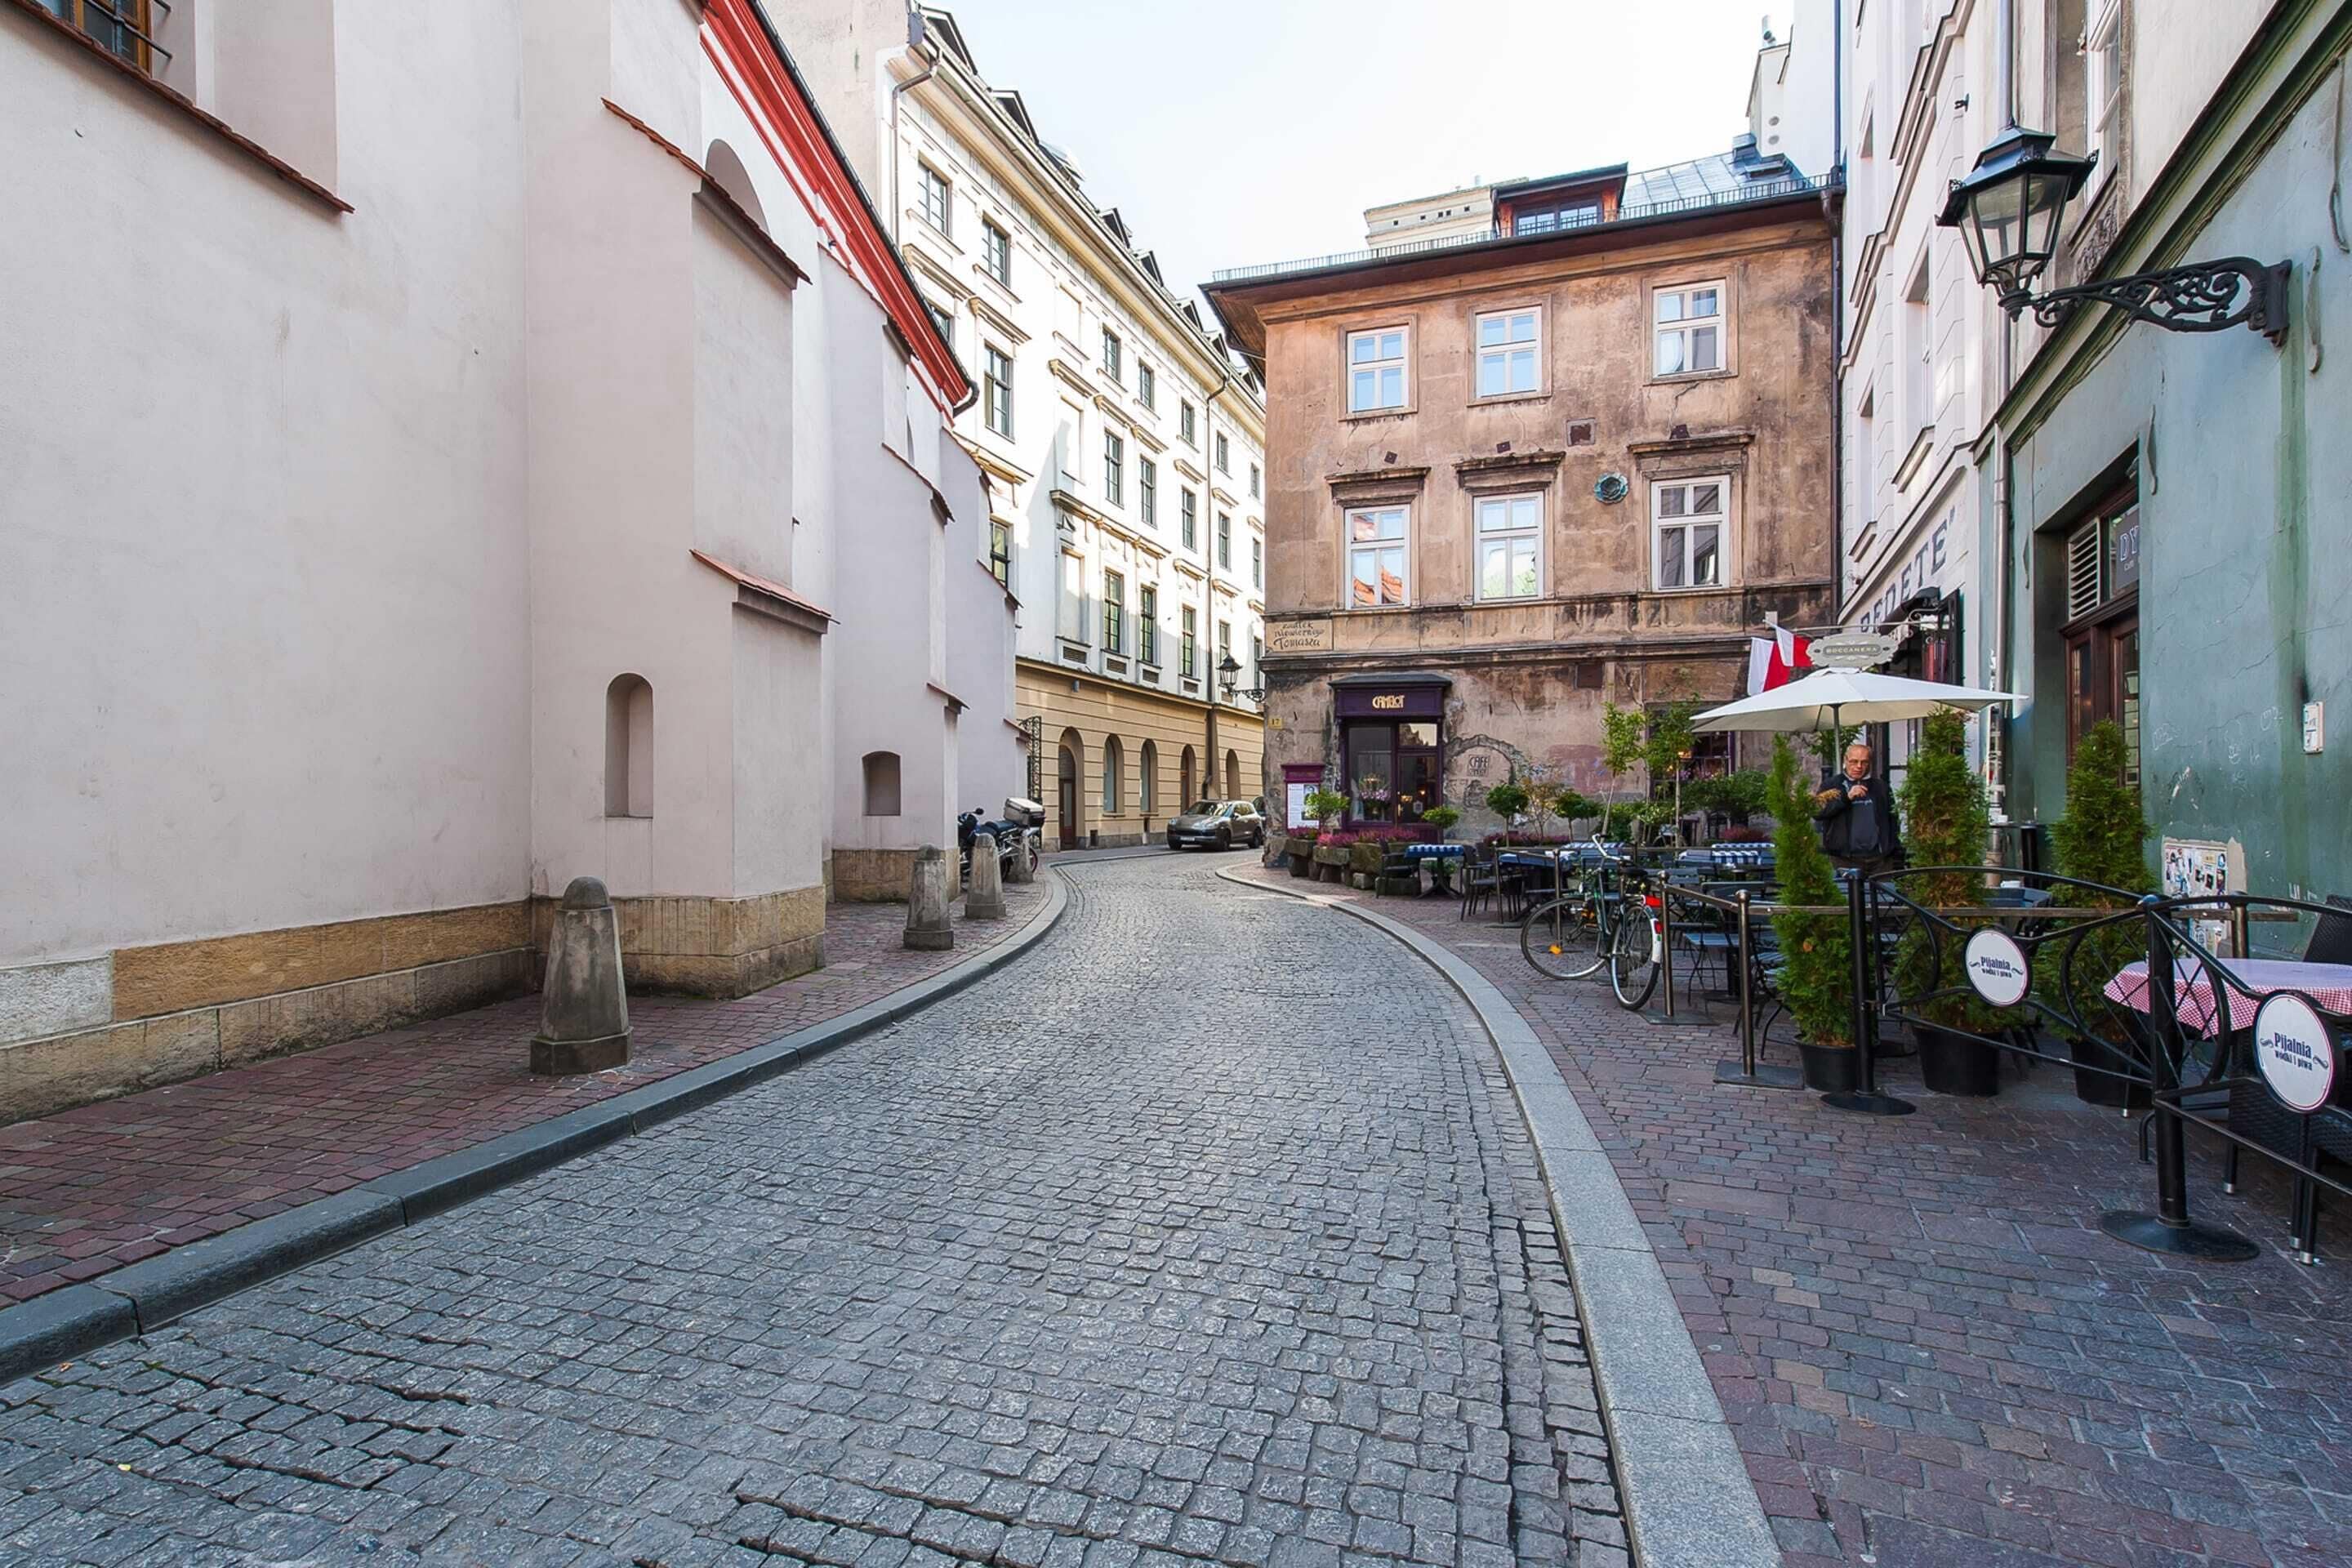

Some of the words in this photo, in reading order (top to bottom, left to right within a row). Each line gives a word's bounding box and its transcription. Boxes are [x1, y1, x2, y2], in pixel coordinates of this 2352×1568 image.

[1273, 636, 1321, 650] Tomasza
[1372, 695, 1405, 709] CAMELOT
[1980, 956, 2011, 971] Pijalnia
[2274, 1031, 2312, 1059] Pijalnia
[2297, 1058, 2313, 1071] piwa
